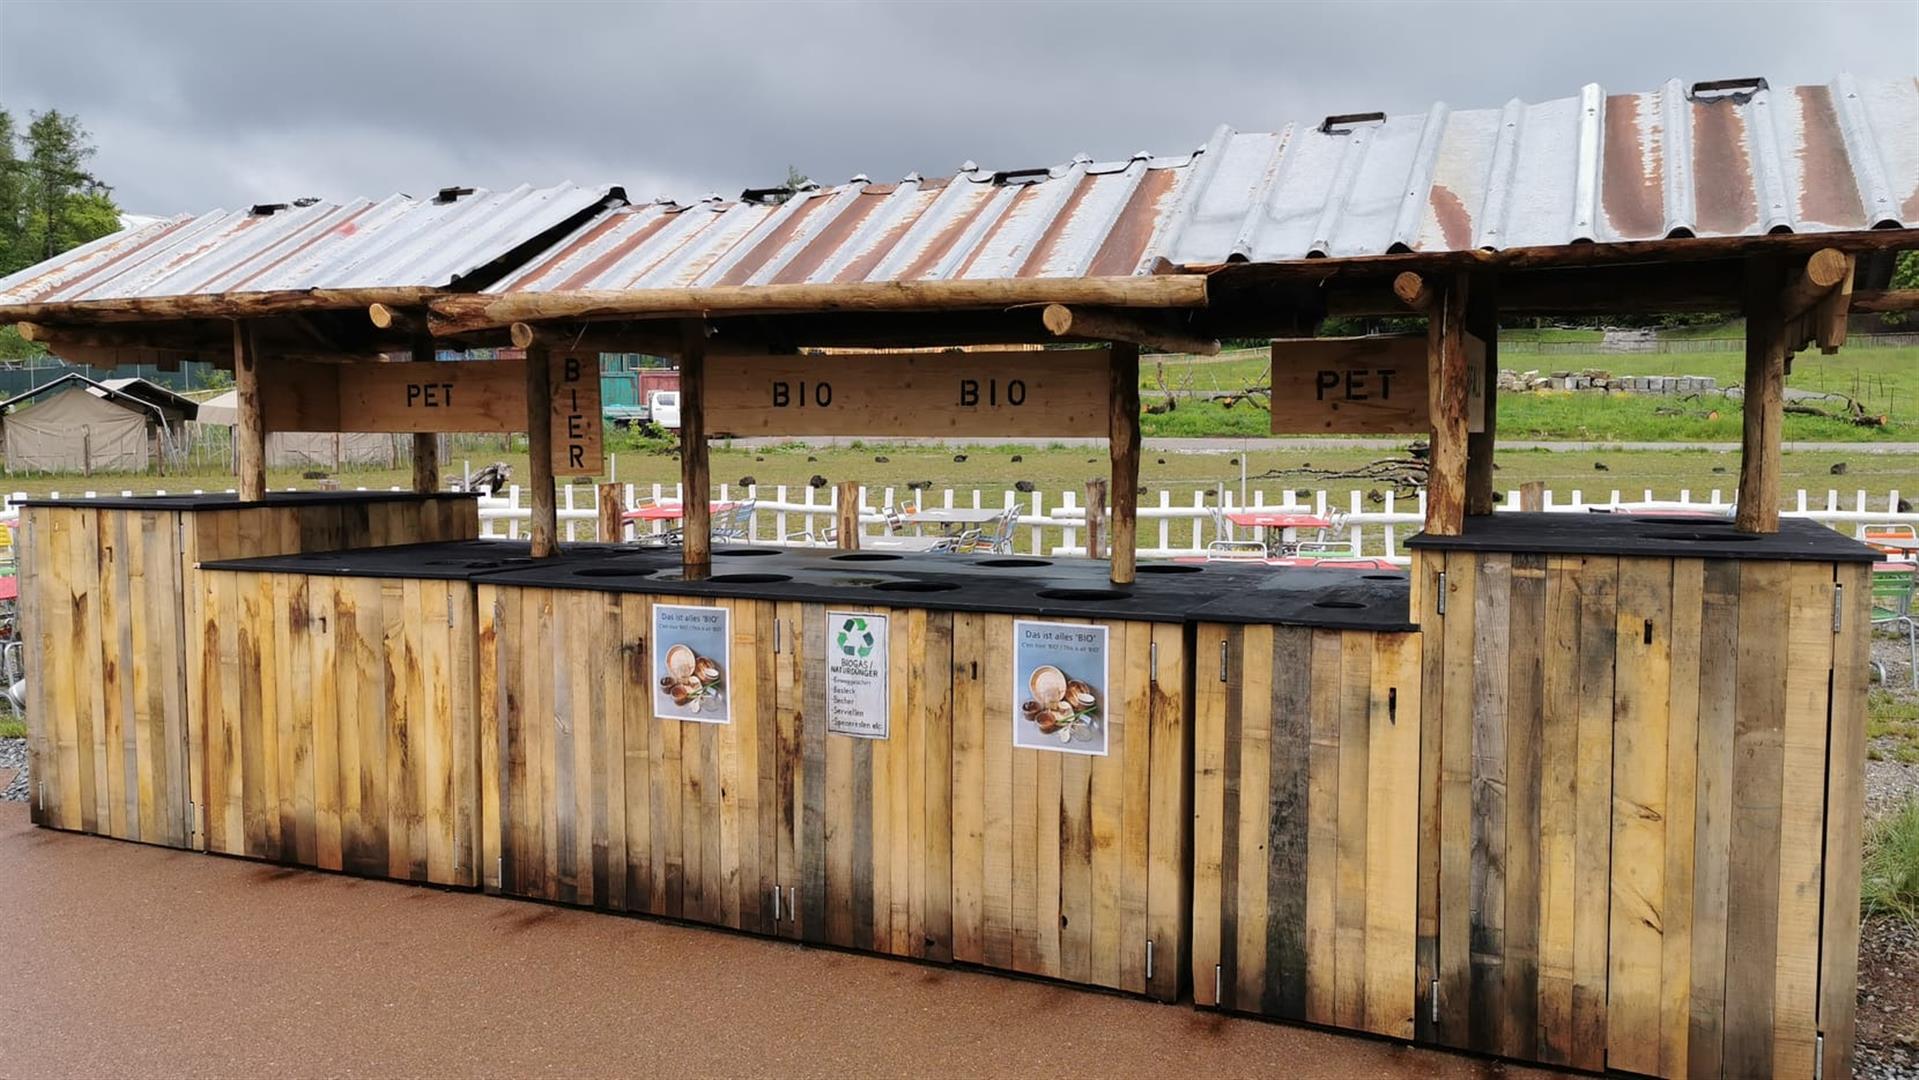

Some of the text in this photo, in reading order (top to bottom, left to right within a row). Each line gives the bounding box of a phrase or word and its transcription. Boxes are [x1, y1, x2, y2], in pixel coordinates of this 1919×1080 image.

[406, 384, 454, 407] PET
[773, 379, 1026, 407] BIO BIO
[1316, 369, 1396, 400] PET
[564, 357, 584, 469] BIER
[661, 612, 674, 621] Das
[1025, 630, 1041, 639] Das
[1043, 631, 1053, 641] ist
[1055, 632, 1073, 641] alles
